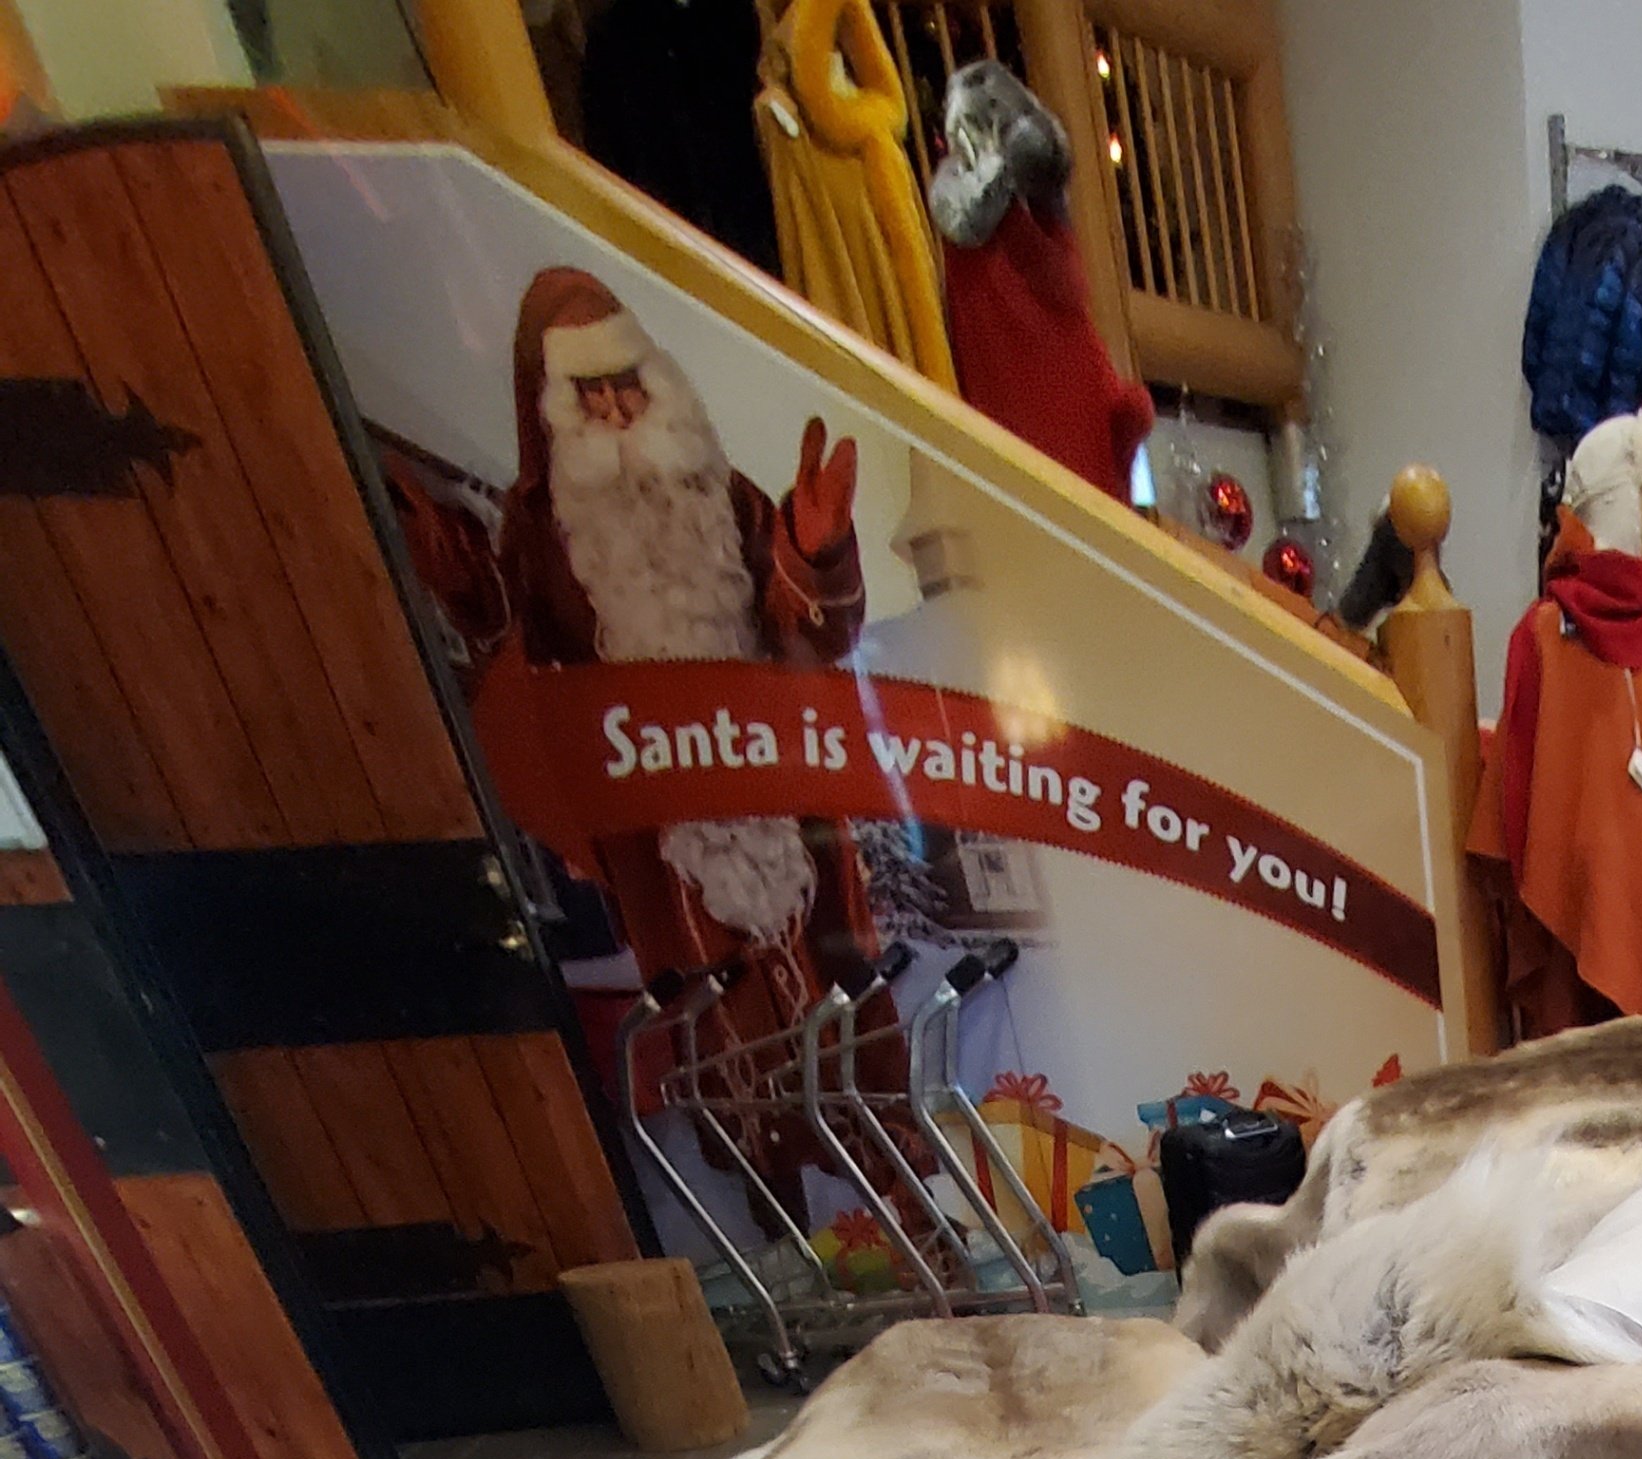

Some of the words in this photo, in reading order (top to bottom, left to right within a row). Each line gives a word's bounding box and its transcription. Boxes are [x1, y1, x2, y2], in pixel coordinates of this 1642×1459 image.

[603, 704, 779, 779] Santa
[802, 706, 848, 771] is
[866, 730, 1102, 833] waiting
[1120, 778, 1210, 852] for
[1225, 834, 1348, 922] you!
